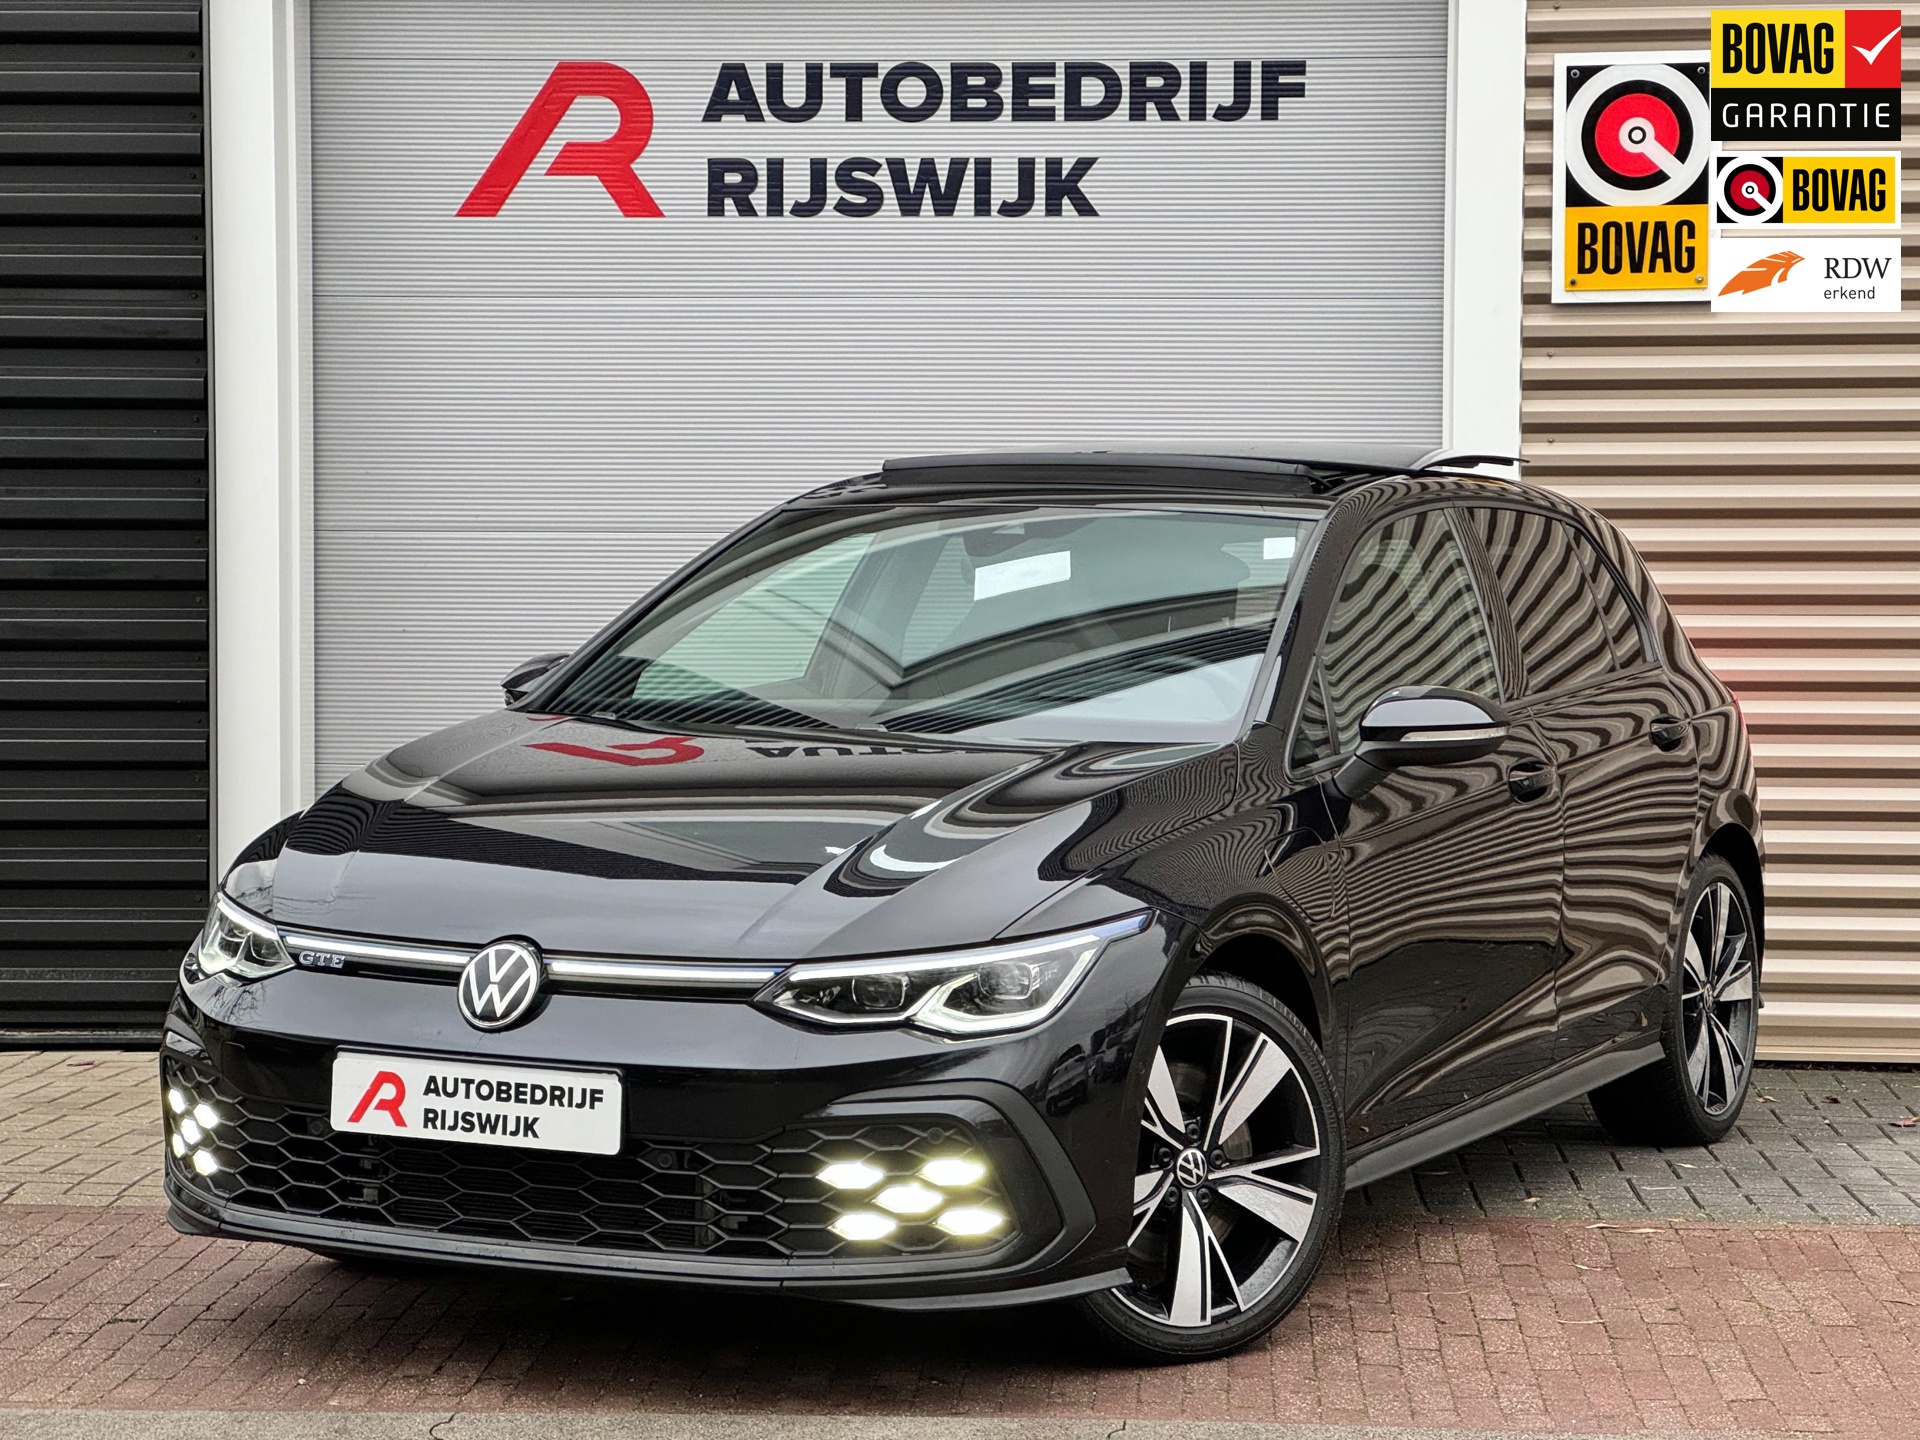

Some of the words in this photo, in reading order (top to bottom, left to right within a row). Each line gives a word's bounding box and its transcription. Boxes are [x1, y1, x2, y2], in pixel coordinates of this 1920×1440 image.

[702, 60, 1307, 123] AUTOBEDRIJF
[707, 156, 1101, 218] RIJSWIJK
[1577, 219, 1696, 275] BOVAG
[298, 950, 346, 969] GTE
[422, 1075, 604, 1110] AUTOBEDRIJF
[422, 1107, 541, 1139] RIJSWIJK
